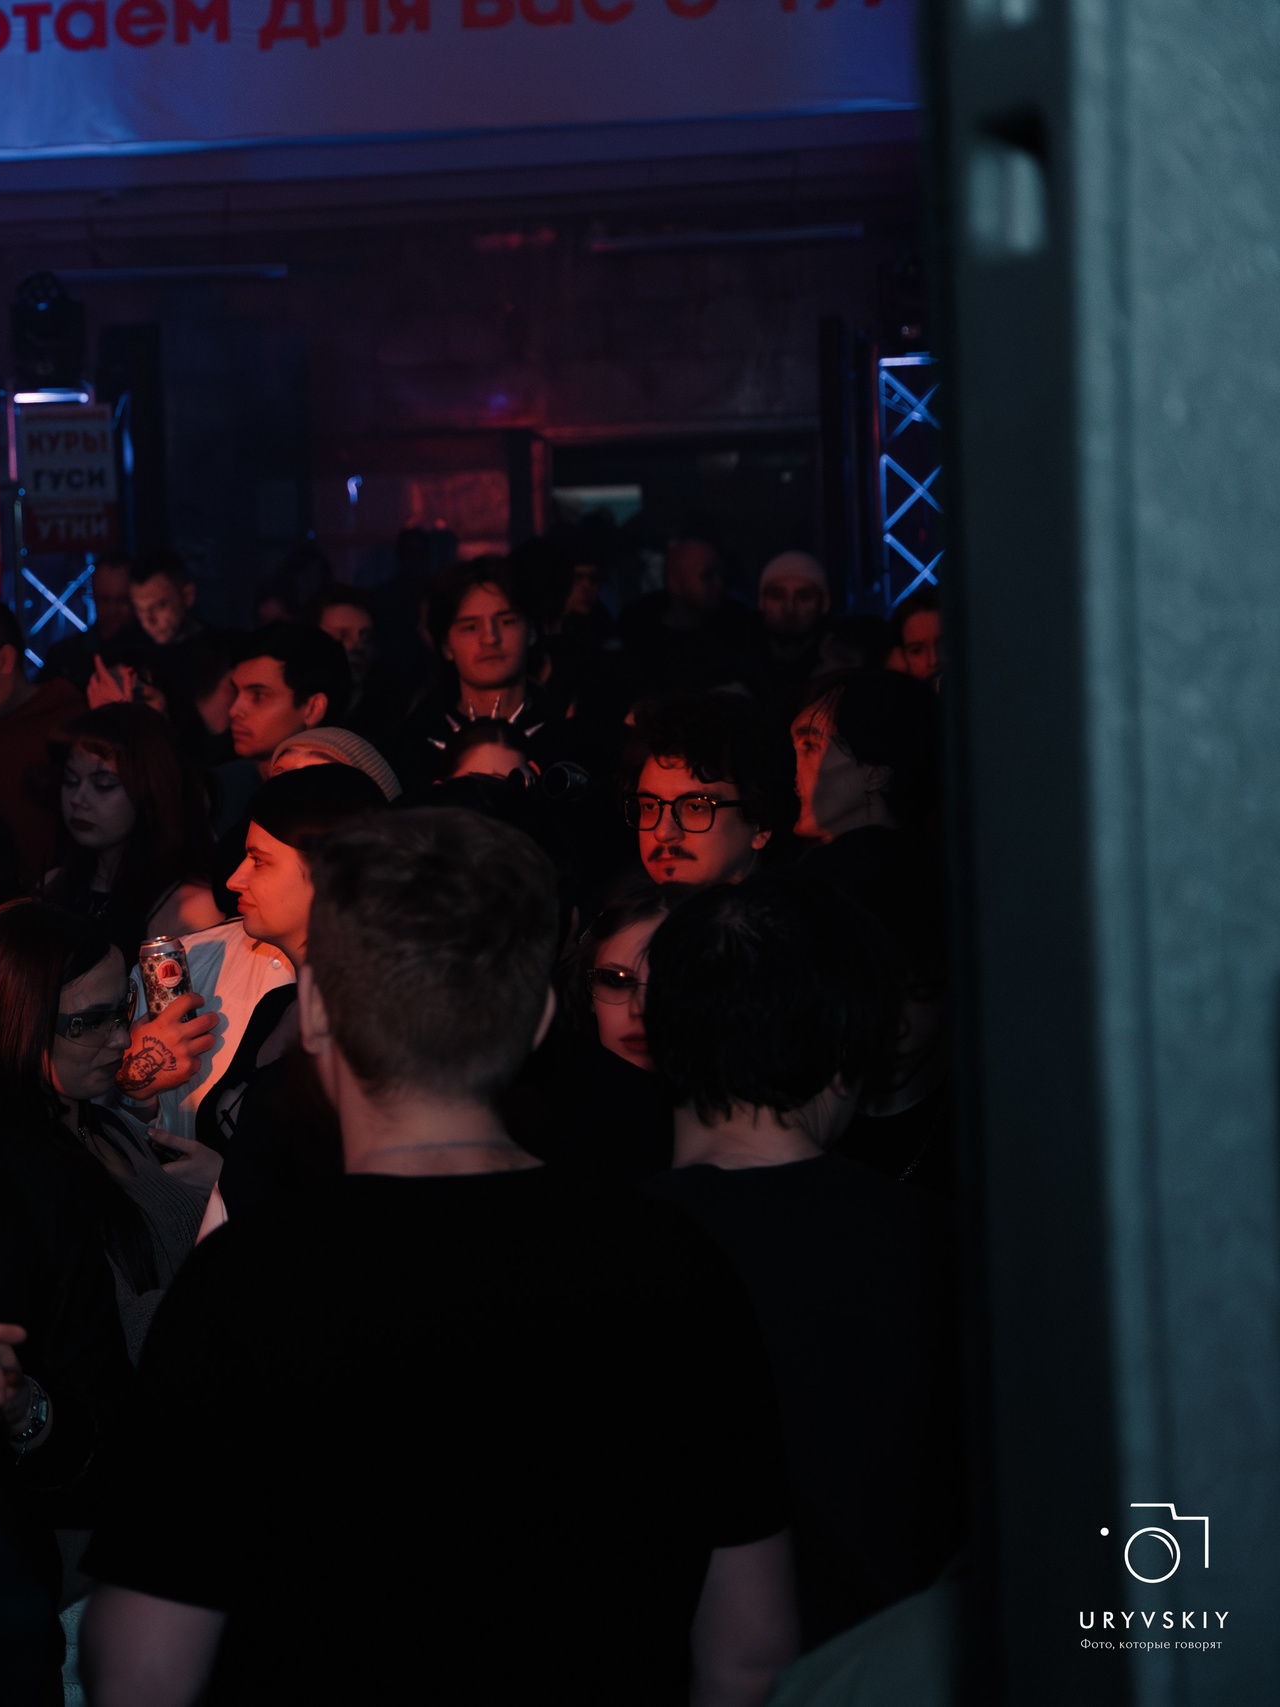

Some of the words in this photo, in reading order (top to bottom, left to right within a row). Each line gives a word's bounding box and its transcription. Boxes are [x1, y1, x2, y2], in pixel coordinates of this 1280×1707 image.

[259, 0, 430, 50] для
[28, 430, 108, 454] КУРЫ
[33, 467, 105, 491] ГУСИ
[37, 515, 109, 540] УТКИ
